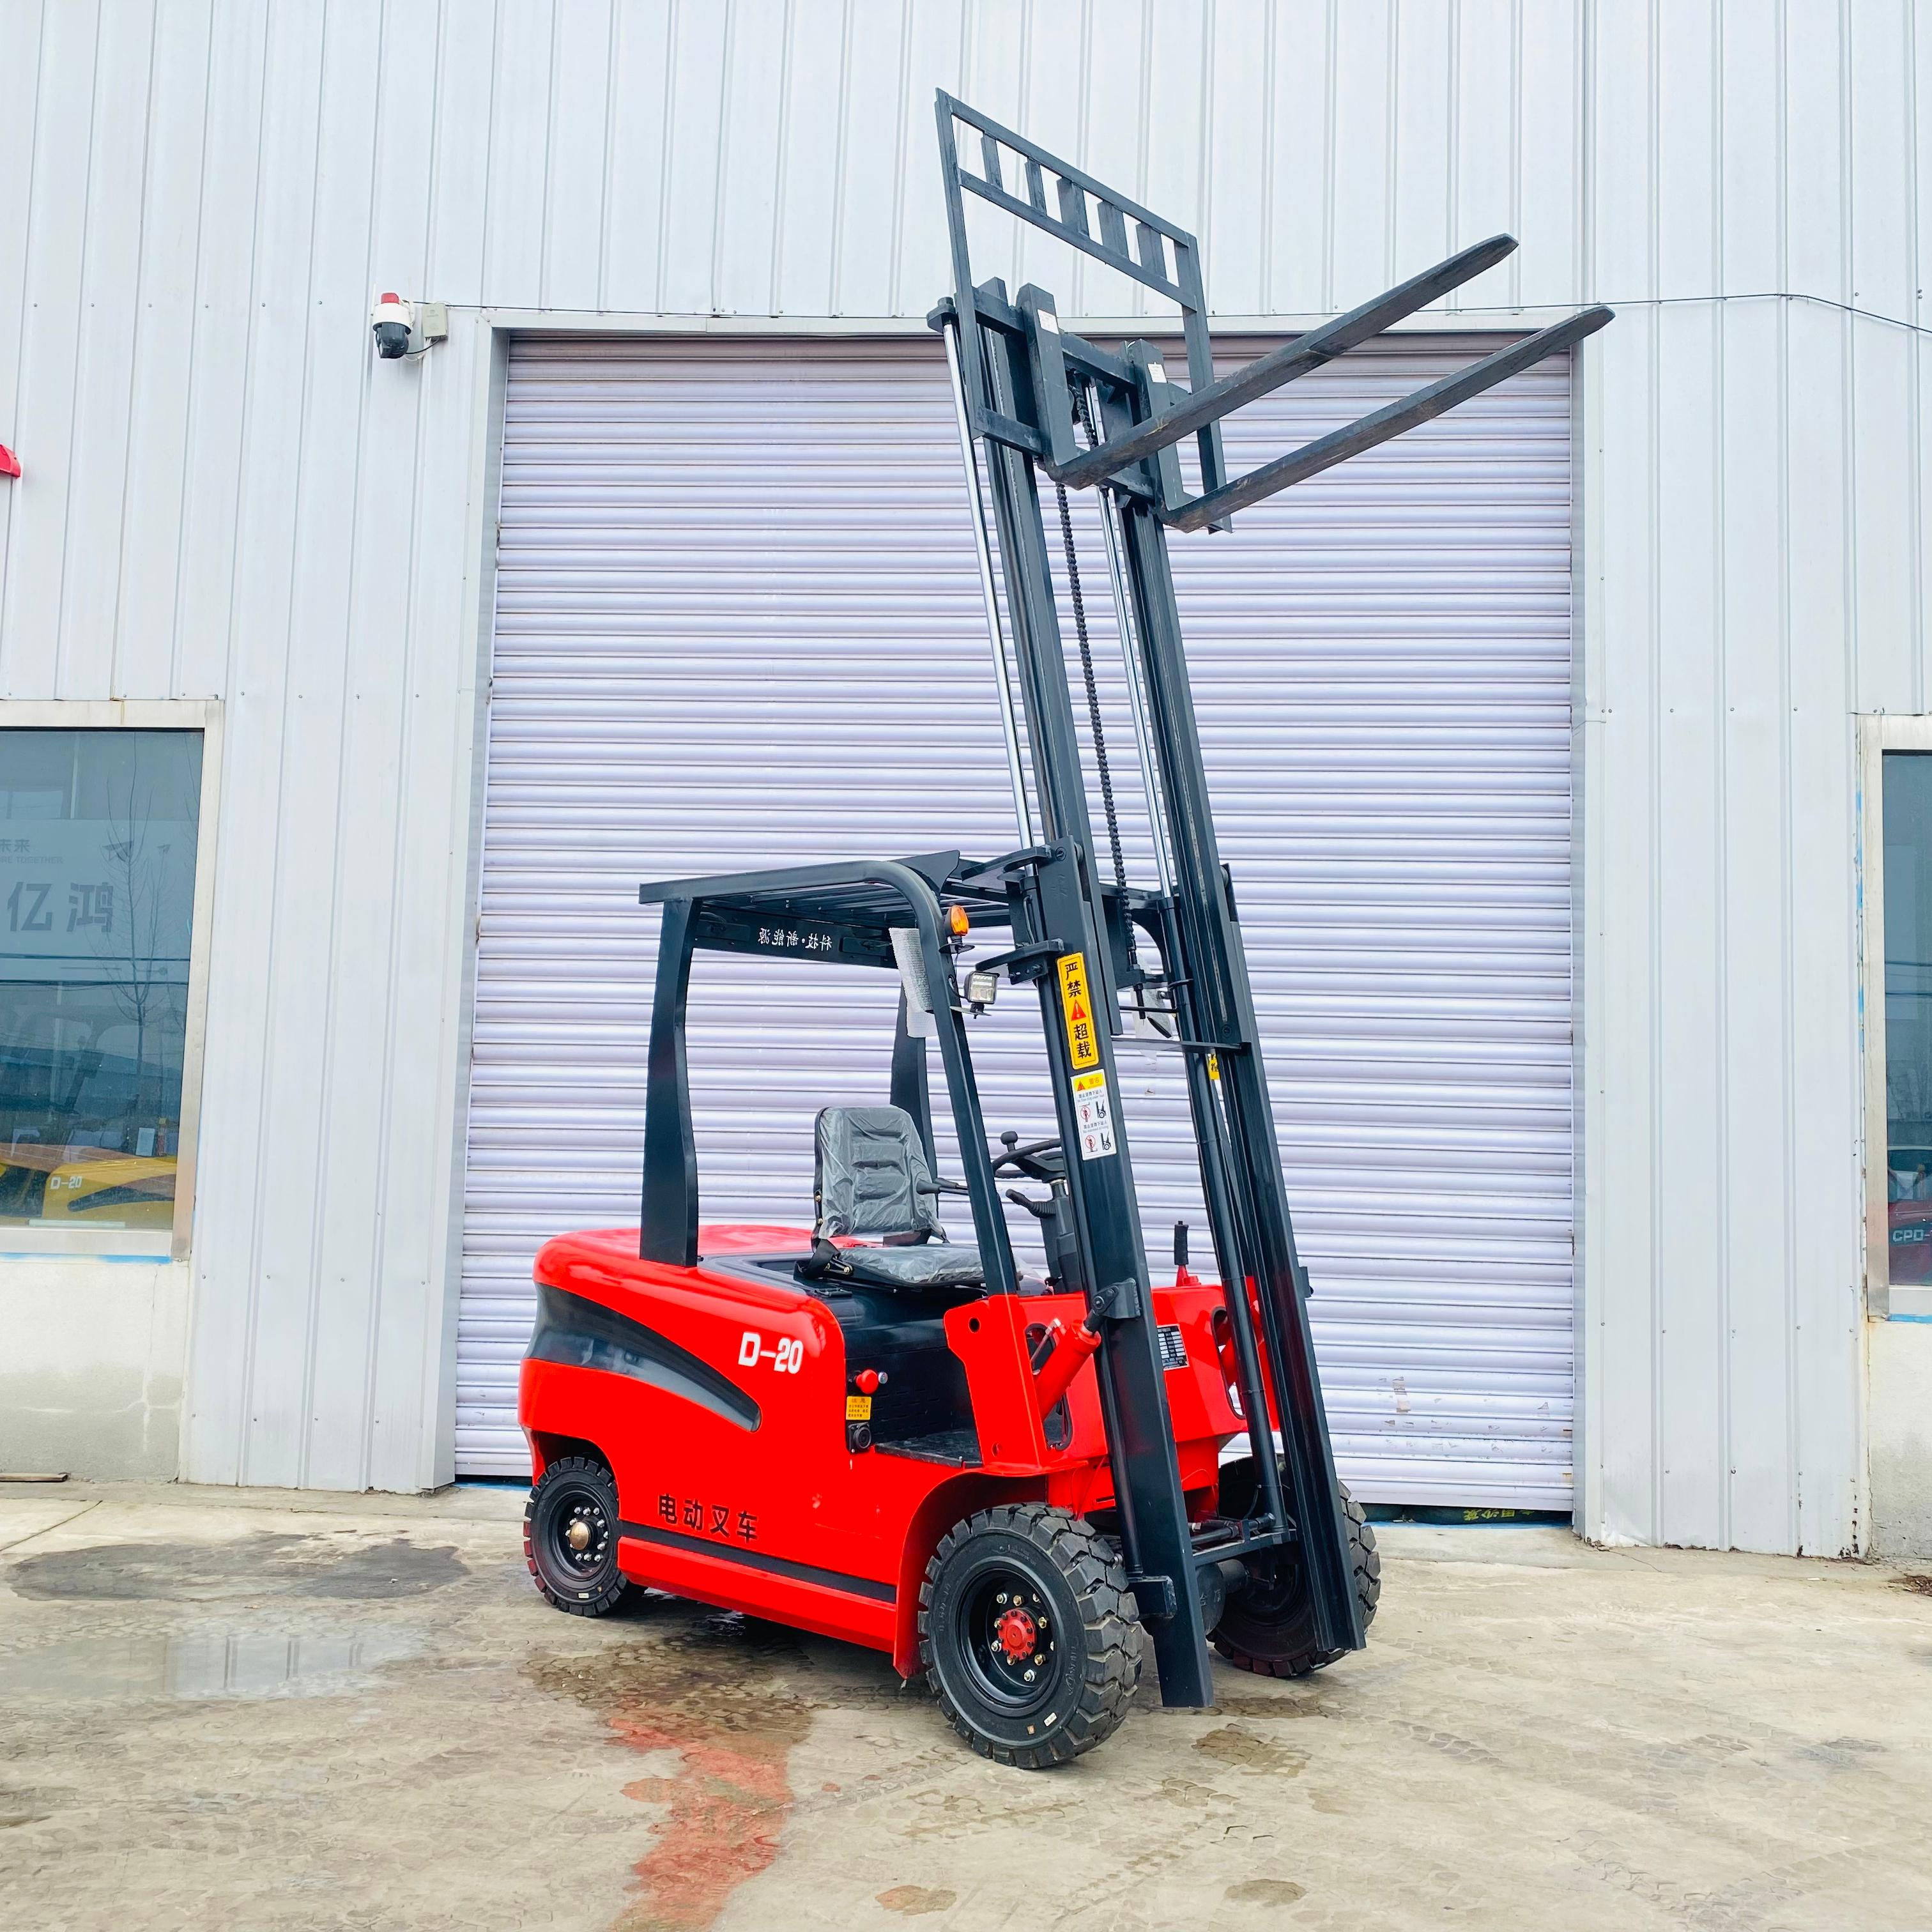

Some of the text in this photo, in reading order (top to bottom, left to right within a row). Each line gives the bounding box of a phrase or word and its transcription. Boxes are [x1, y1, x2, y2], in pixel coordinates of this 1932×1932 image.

[7, 882, 114, 932] 亿鸿
[50, 1176, 82, 1190] D-20
[1892, 1229, 1932, 1243] CPD-
[738, 1331, 804, 1374] D-20
[658, 1493, 758, 1543] 电动叉车
